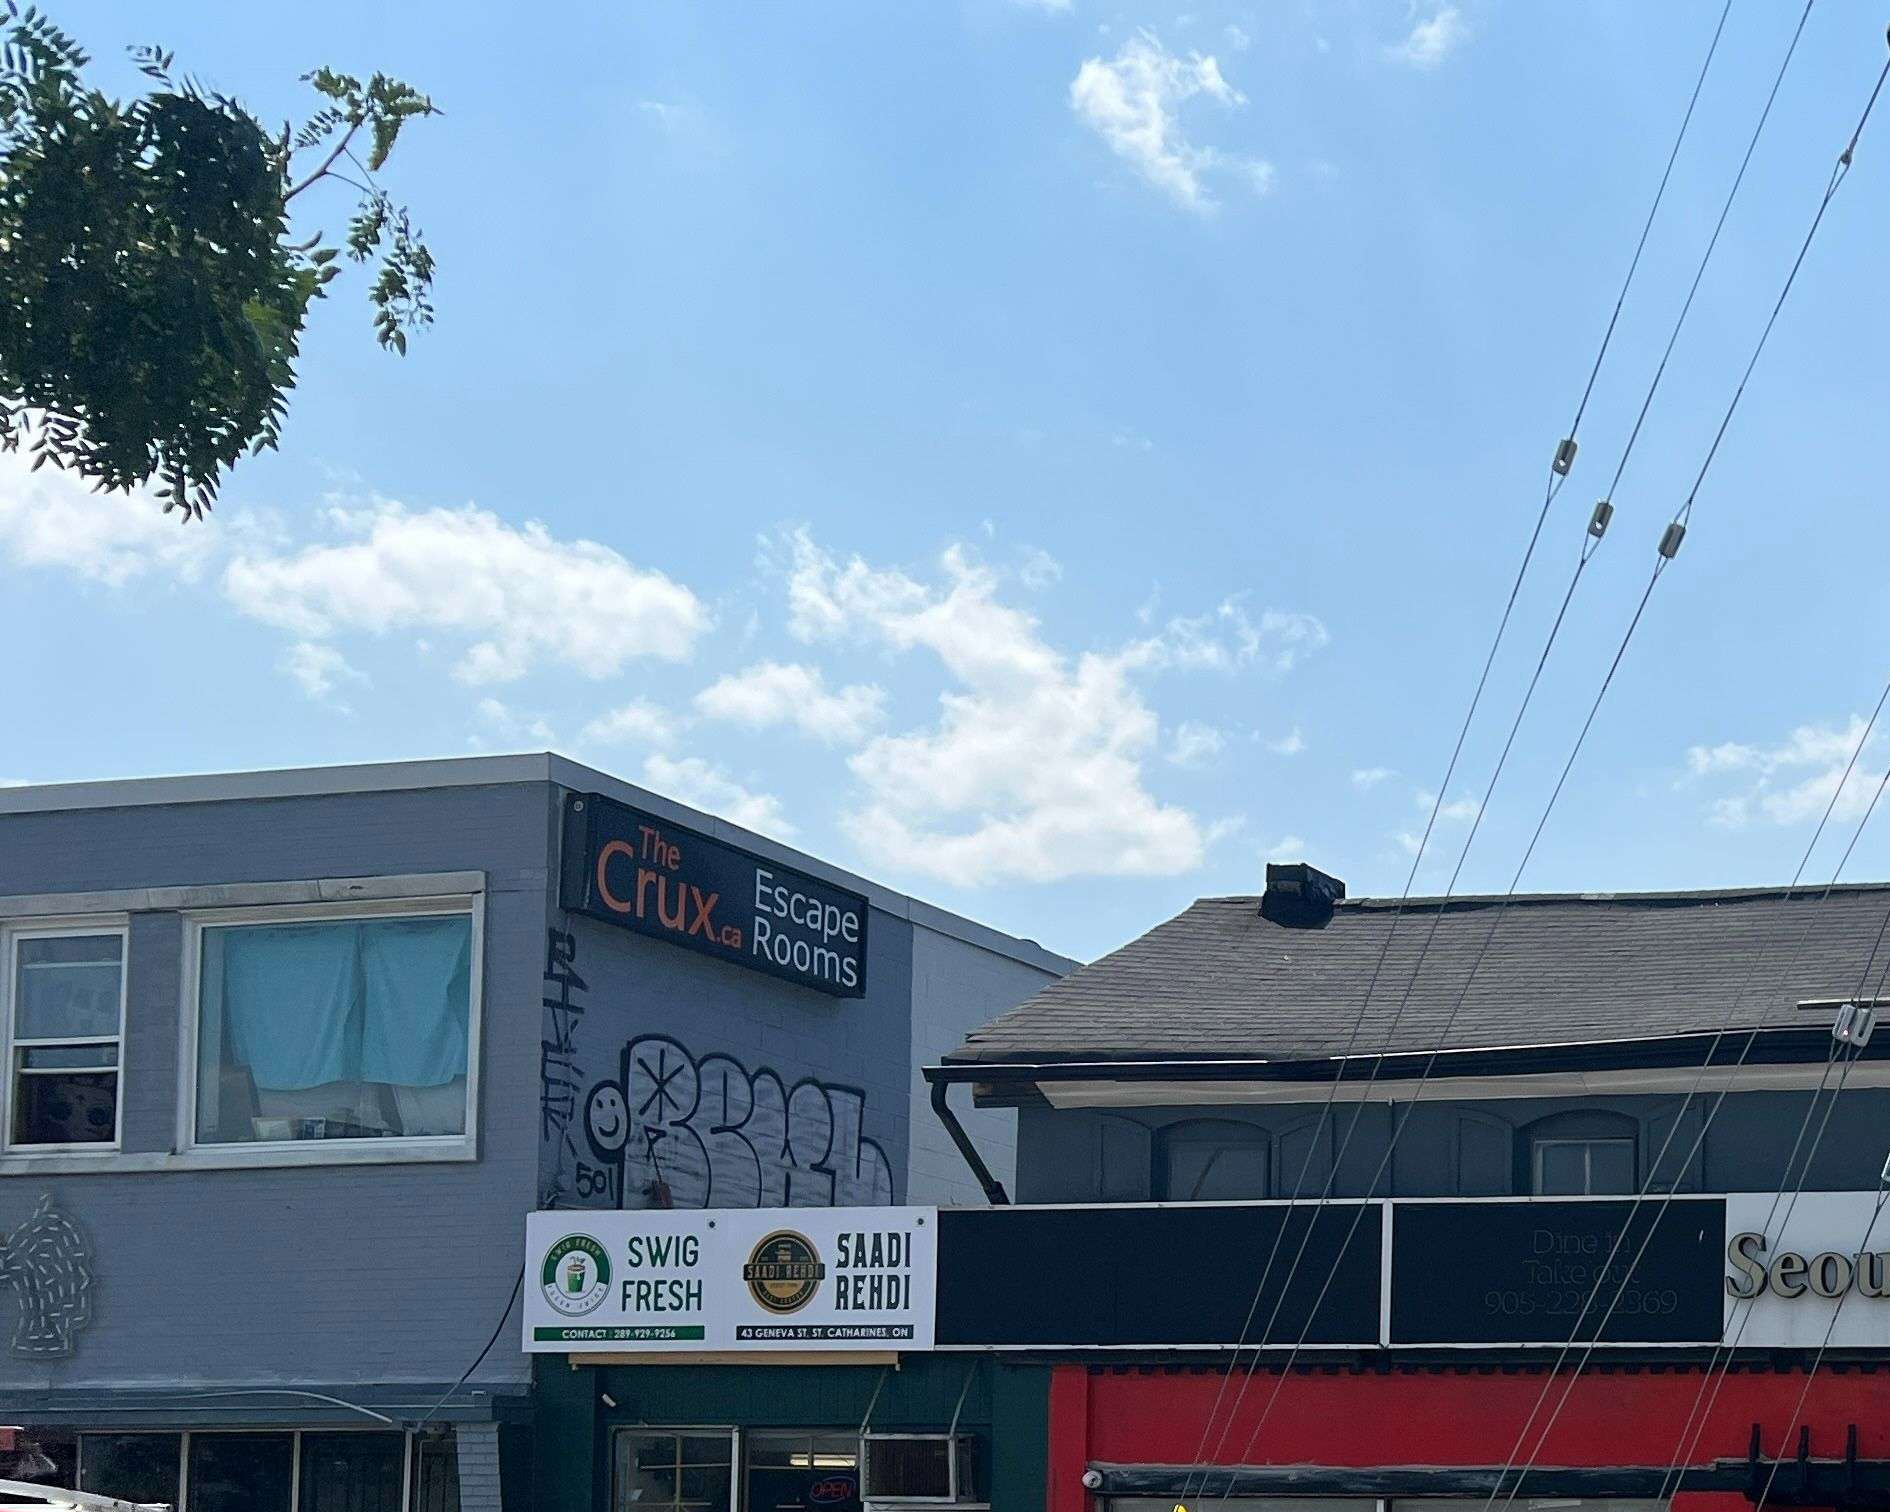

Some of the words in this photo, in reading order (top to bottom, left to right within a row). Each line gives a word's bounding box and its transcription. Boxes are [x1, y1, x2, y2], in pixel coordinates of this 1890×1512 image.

[638, 825, 681, 871] The
[754, 867, 860, 944] Escape
[752, 915, 858, 988] Rooms
[627, 1234, 700, 1268] SWIG
[835, 1232, 912, 1268] SAADI
[1532, 1229, 1599, 1255] Dine
[621, 1279, 703, 1313] FRESH
[834, 1274, 912, 1310] REHDI
[755, 1327, 795, 1338] GENEVA
[892, 1326, 909, 1338] ON
[812, 1482, 850, 1498] OPEN
